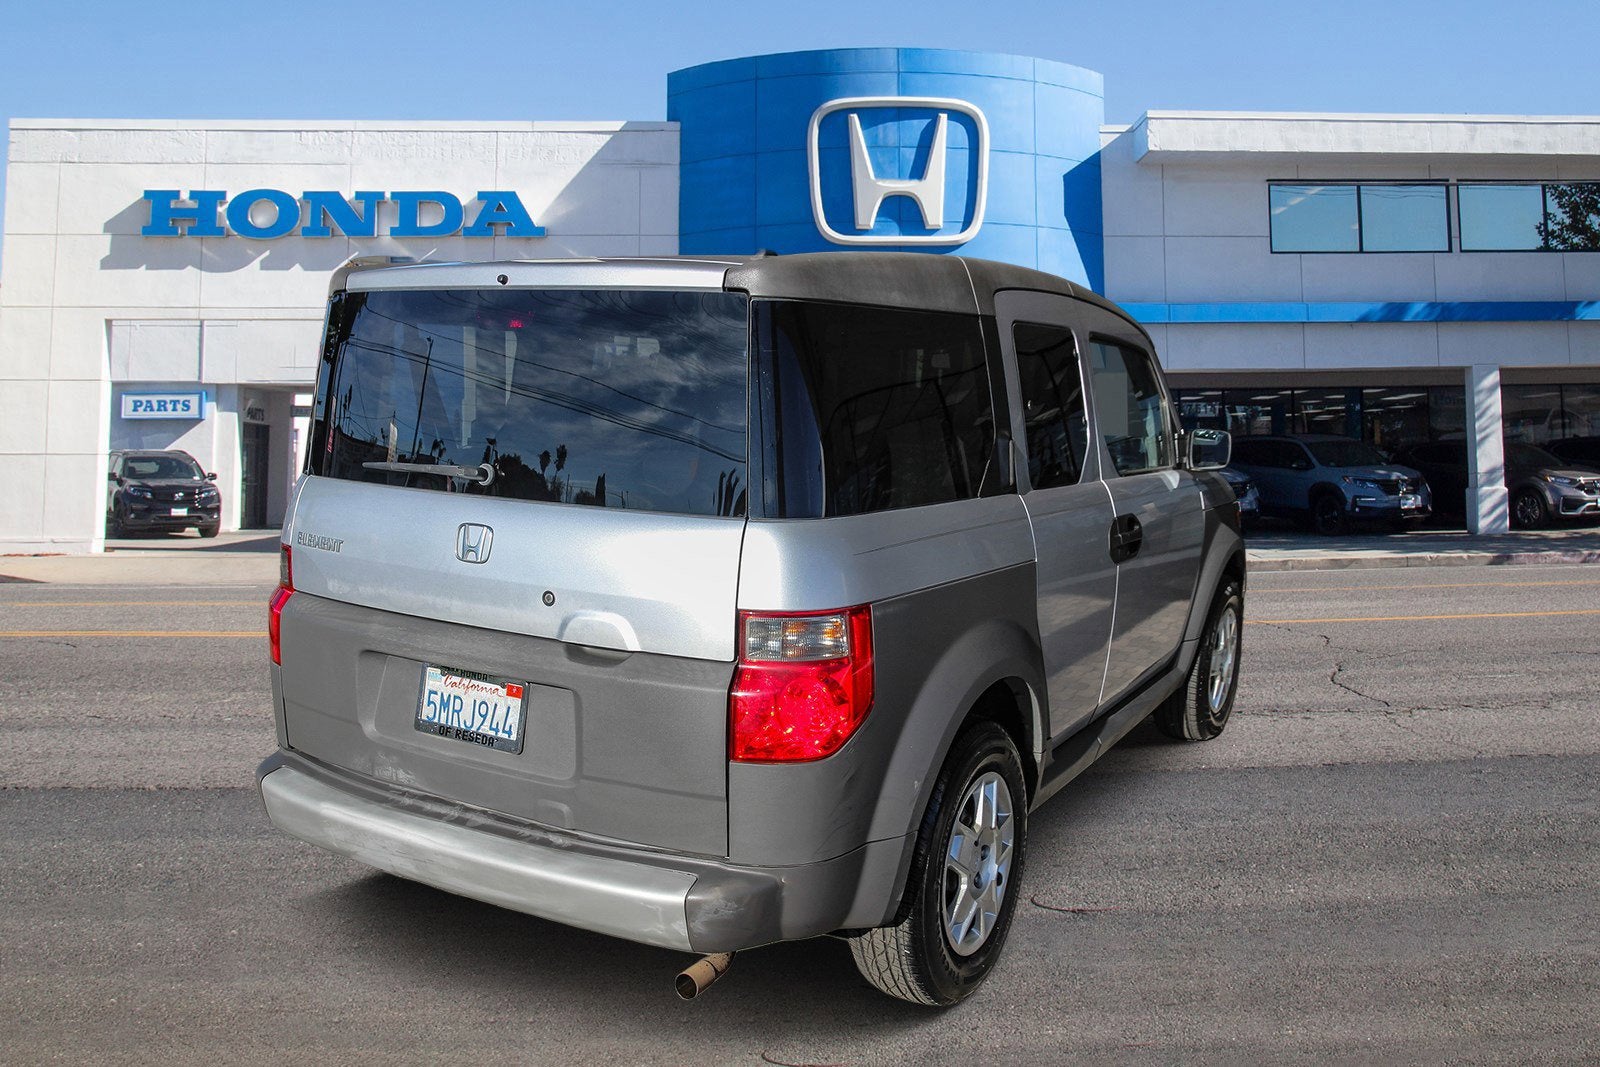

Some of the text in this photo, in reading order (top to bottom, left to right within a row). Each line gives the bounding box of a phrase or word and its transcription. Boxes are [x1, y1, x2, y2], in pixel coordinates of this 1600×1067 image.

[141, 189, 547, 239] HONDA
[131, 399, 191, 412] PARTS
[443, 673, 504, 697] California
[460, 671, 489, 682] HONDA
[426, 689, 513, 739] 5MRJ944
[438, 727, 495, 747] OF RESEDA
